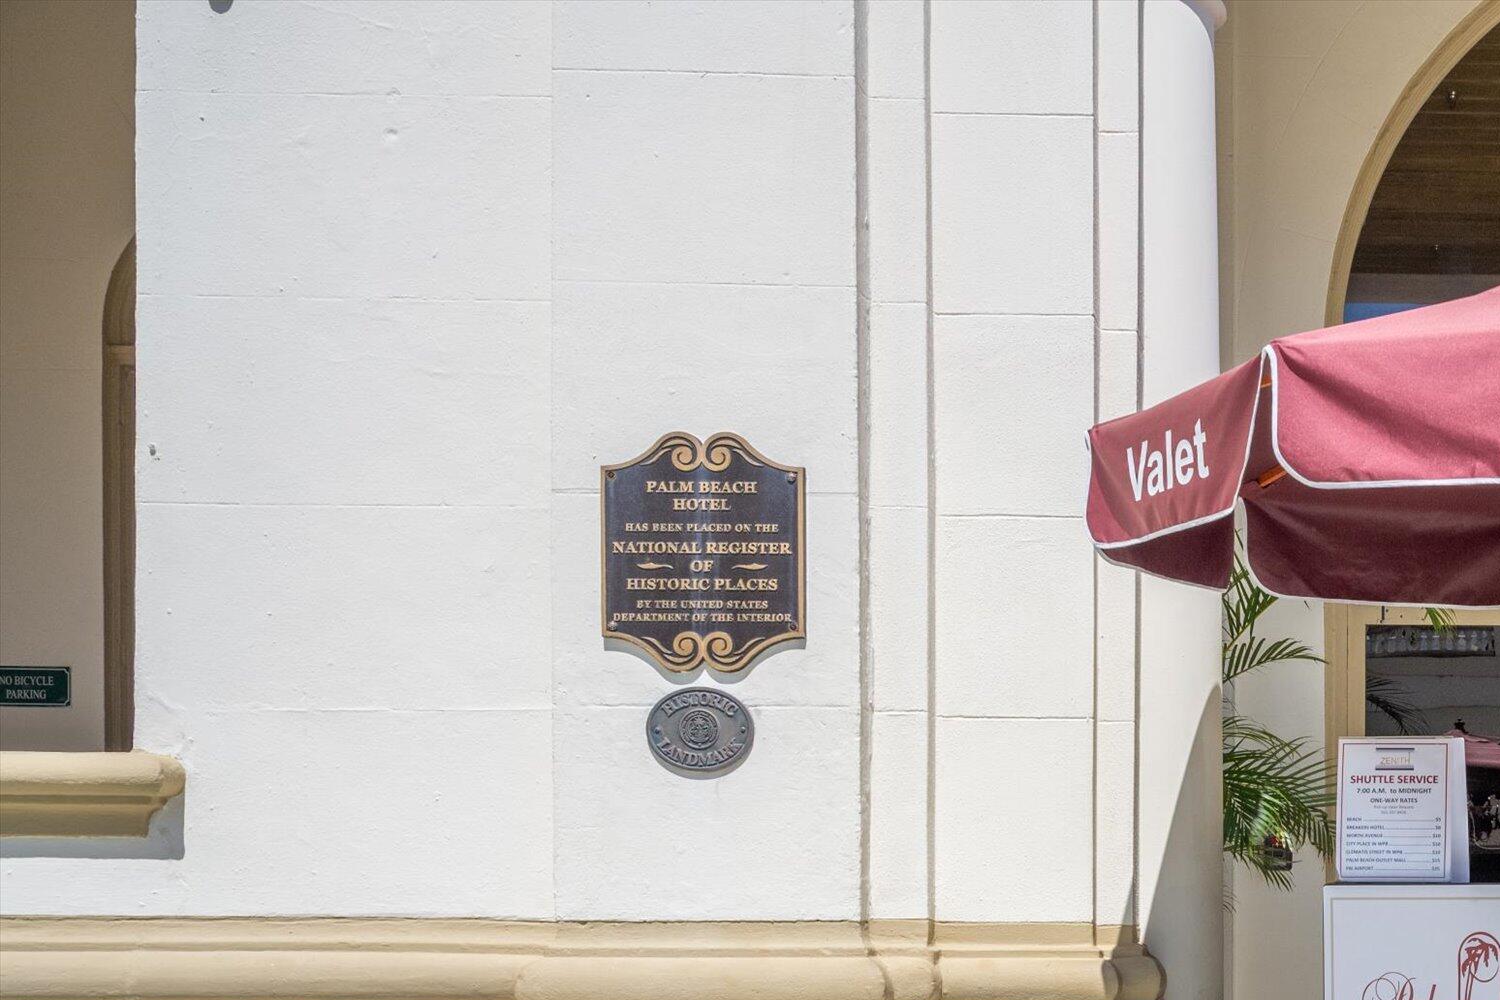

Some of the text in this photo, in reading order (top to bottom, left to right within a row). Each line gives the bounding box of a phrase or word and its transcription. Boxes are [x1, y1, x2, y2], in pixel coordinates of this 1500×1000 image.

[1125, 418, 1210, 502] Valet
[646, 480, 757, 493] PALM BEACH
[673, 499, 731, 511] HOTEL
[625, 523, 779, 533] HAS BEEN PLACED ON THE
[612, 541, 792, 554] NATIONAL REGISTER
[690, 560, 714, 573] OF
[626, 578, 778, 591] HISTORIC PLACES
[636, 600, 768, 609] BY THE UNITED STATES
[613, 613, 792, 622] DEPARTMENT OF THE INTERIOR
[0, 676, 54, 686] NO BICYCLE
[6, 689, 47, 699] PARKING
[661, 692, 739, 718] HISTORIC
[657, 737, 744, 766] LANDMARK
[1350, 775, 1439, 784] SHUTTLE SERVICE
